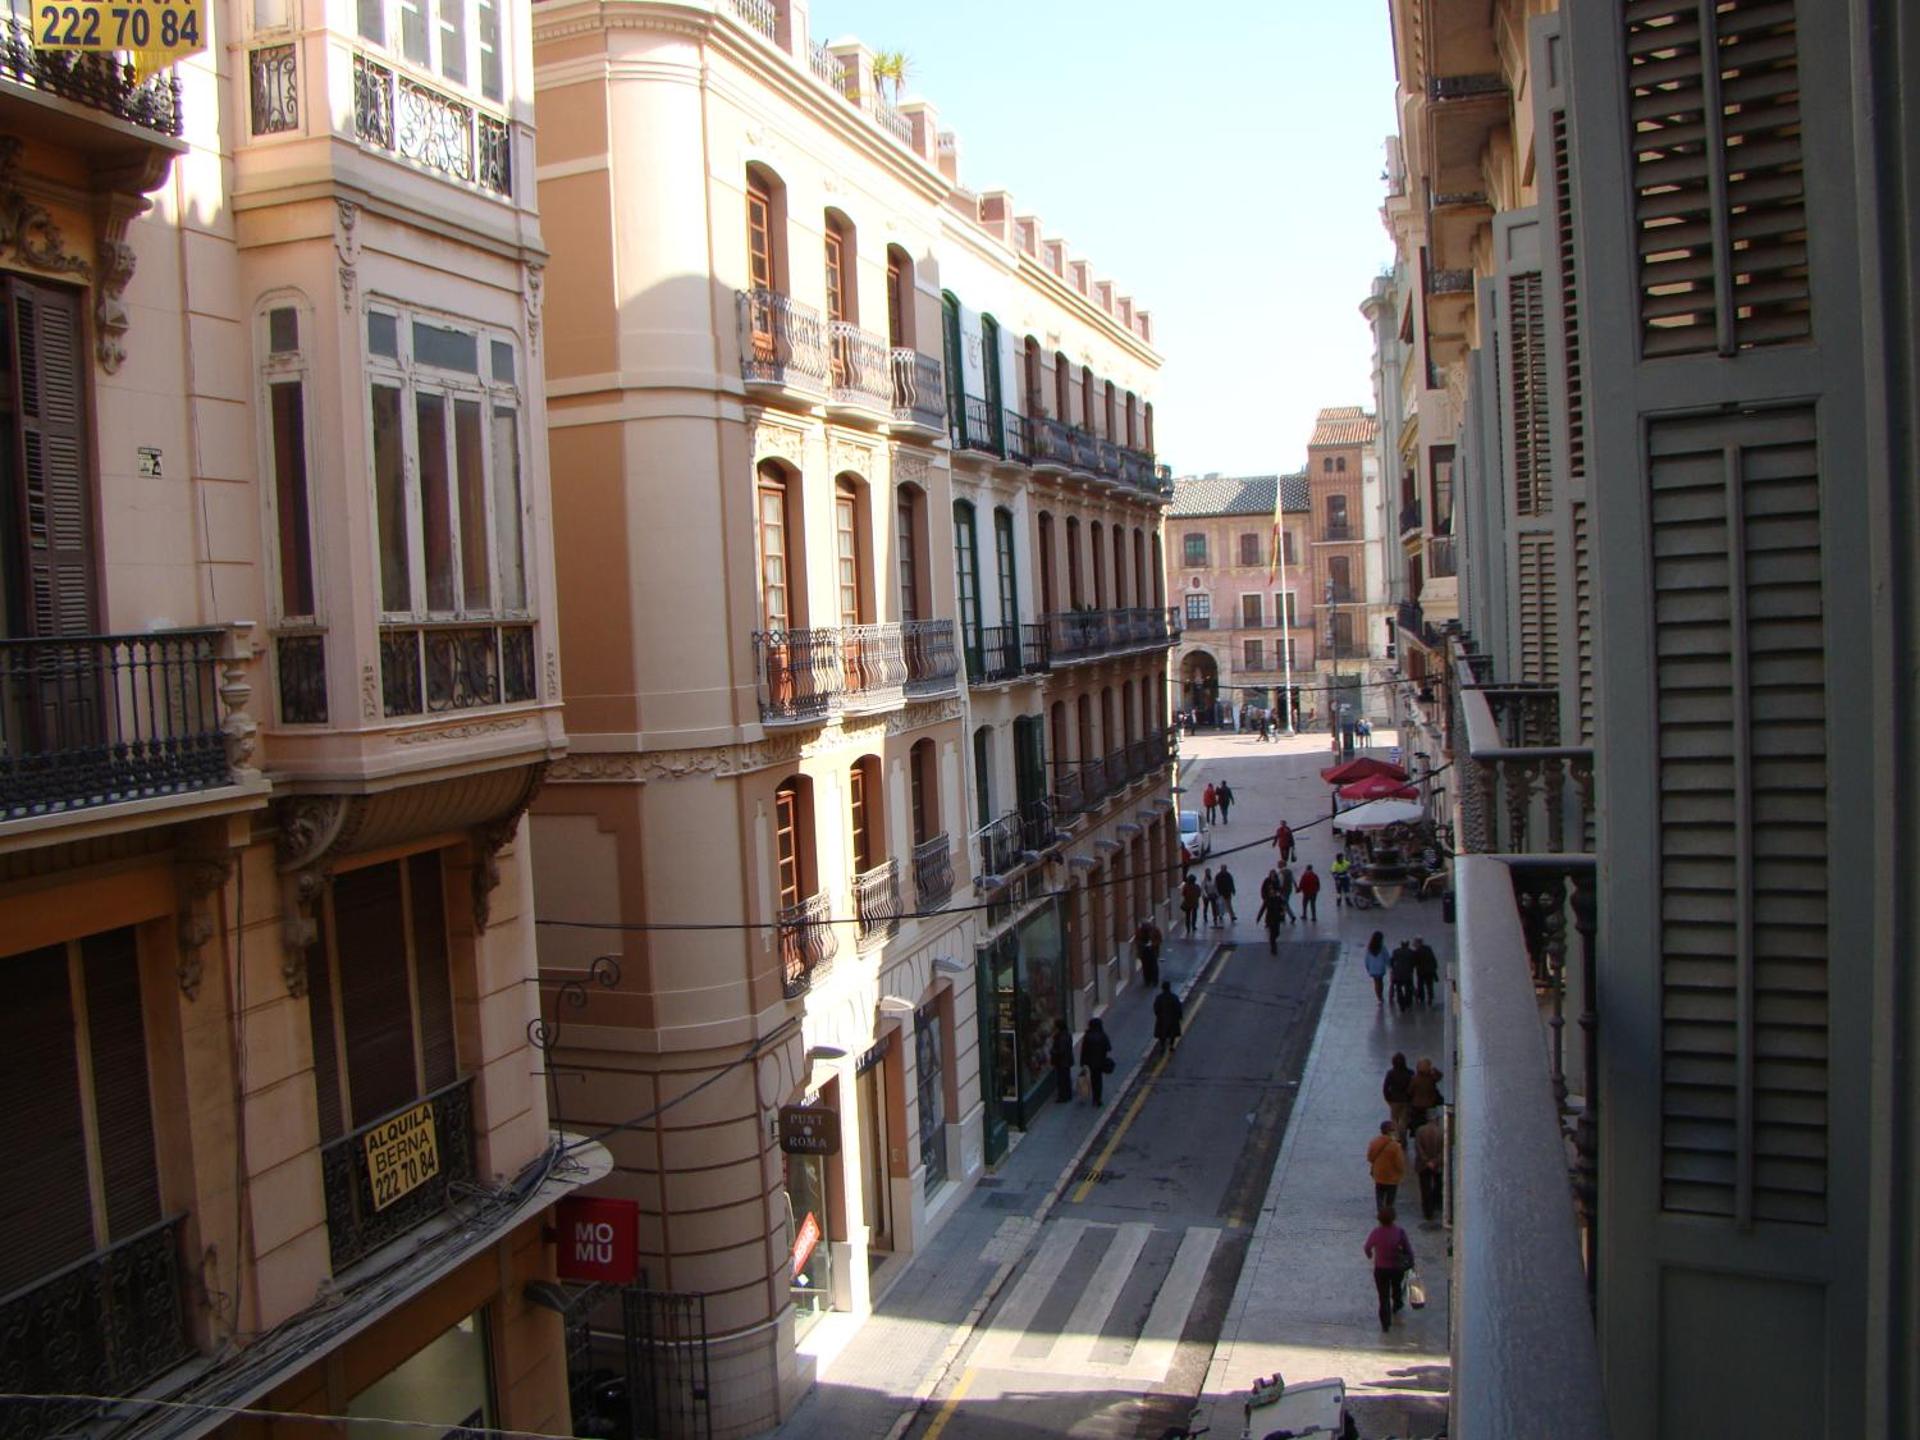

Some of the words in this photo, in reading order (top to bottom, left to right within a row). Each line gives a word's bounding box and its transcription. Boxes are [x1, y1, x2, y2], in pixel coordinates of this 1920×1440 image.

[41, 5, 101, 45] 222
[112, 8, 150, 47] 70
[161, 9, 199, 47] 84
[368, 1105, 432, 1154] ALQUILA
[375, 1127, 430, 1173] BERNA
[789, 1135, 828, 1150] ROMA
[375, 1168, 401, 1205] 222
[401, 1157, 417, 1188] 70
[420, 1146, 435, 1178] 84
[575, 1222, 613, 1243] MO
[575, 1242, 612, 1263] MU
